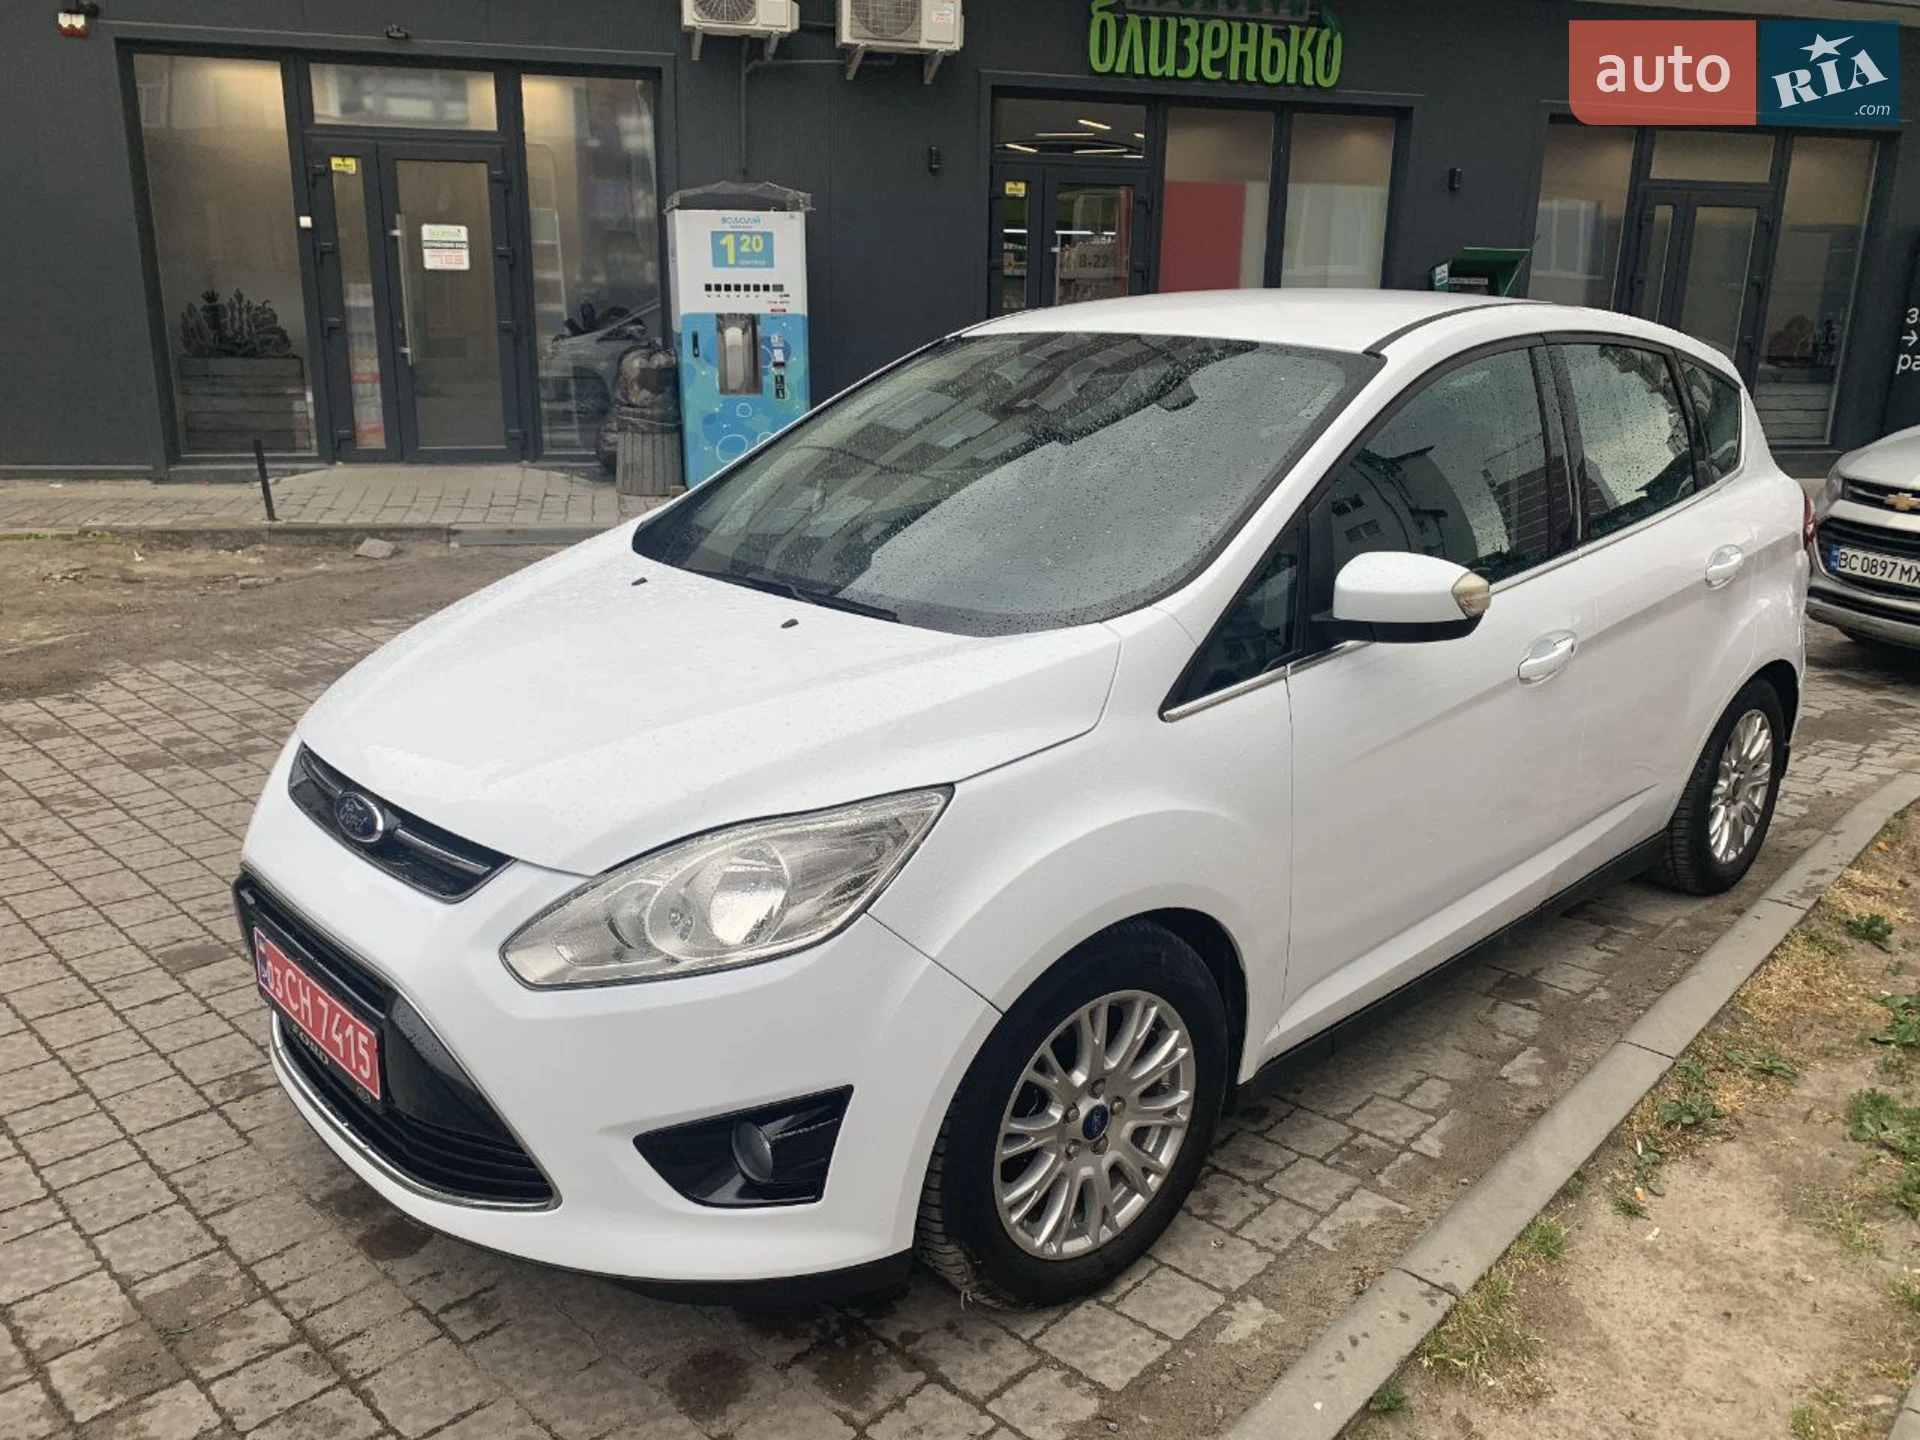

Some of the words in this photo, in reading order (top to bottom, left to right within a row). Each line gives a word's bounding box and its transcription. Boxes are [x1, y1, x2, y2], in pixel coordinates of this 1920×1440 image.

[1089, 0, 1343, 88] близенько
[719, 233, 736, 265] 1
[740, 233, 764, 253] 20
[1838, 551, 1859, 571] BC
[1860, 556, 1898, 579] 0897
[317, 996, 371, 1080] 7415
